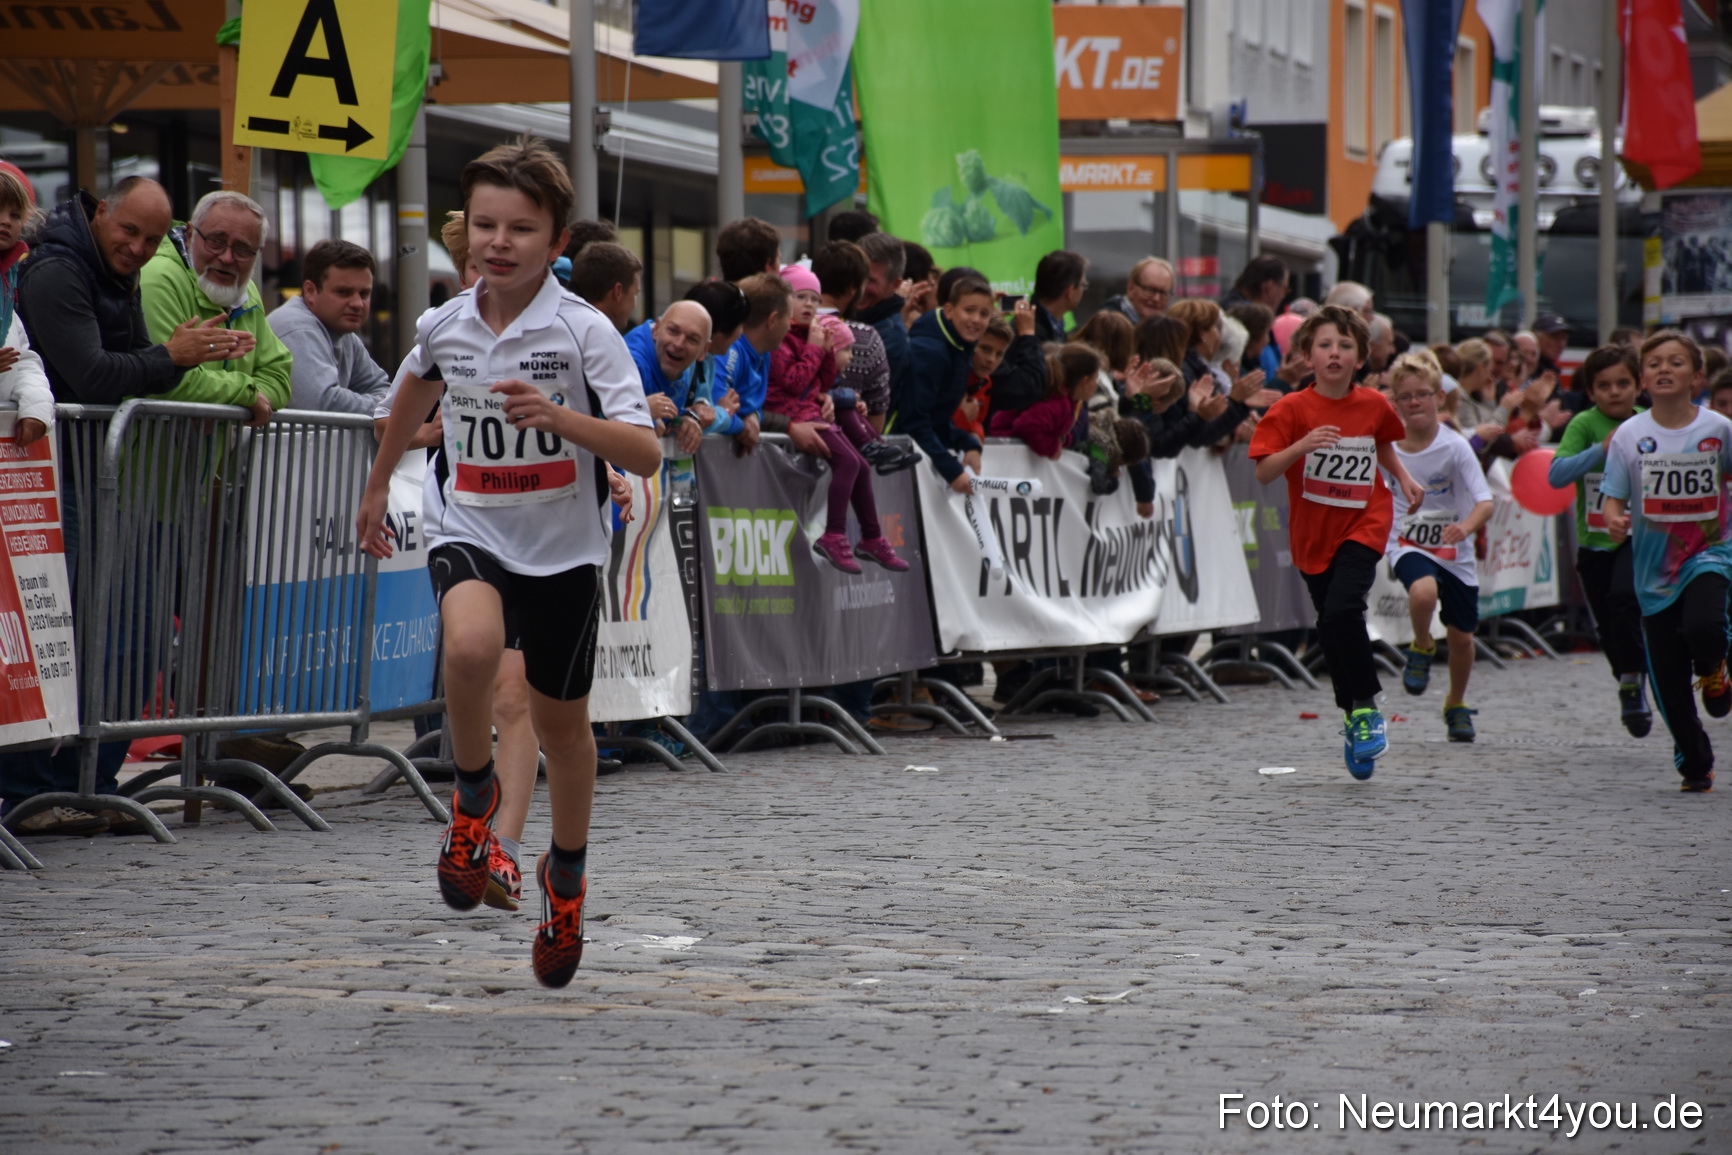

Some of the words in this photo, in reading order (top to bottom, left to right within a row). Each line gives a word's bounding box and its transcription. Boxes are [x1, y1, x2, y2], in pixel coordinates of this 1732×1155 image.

[269, 0, 359, 106] A
[530, 351, 558, 359] SPORT
[451, 365, 477, 379] Philipp
[519, 360, 569, 371] MÜNCH
[532, 372, 557, 380] BERG
[451, 395, 482, 410] PARTL
[1335, 444, 1368, 453] Neumarkt
[1313, 452, 1372, 481] 7222
[1643, 460, 1668, 468] PARTL
[1671, 459, 1708, 467] Neumarkt
[481, 472, 541, 492] Philipp
[1650, 468, 1714, 496] 7063
[1328, 486, 1352, 498] Paul
[1405, 523, 1450, 546] 708
[709, 517, 795, 576] BOCK
